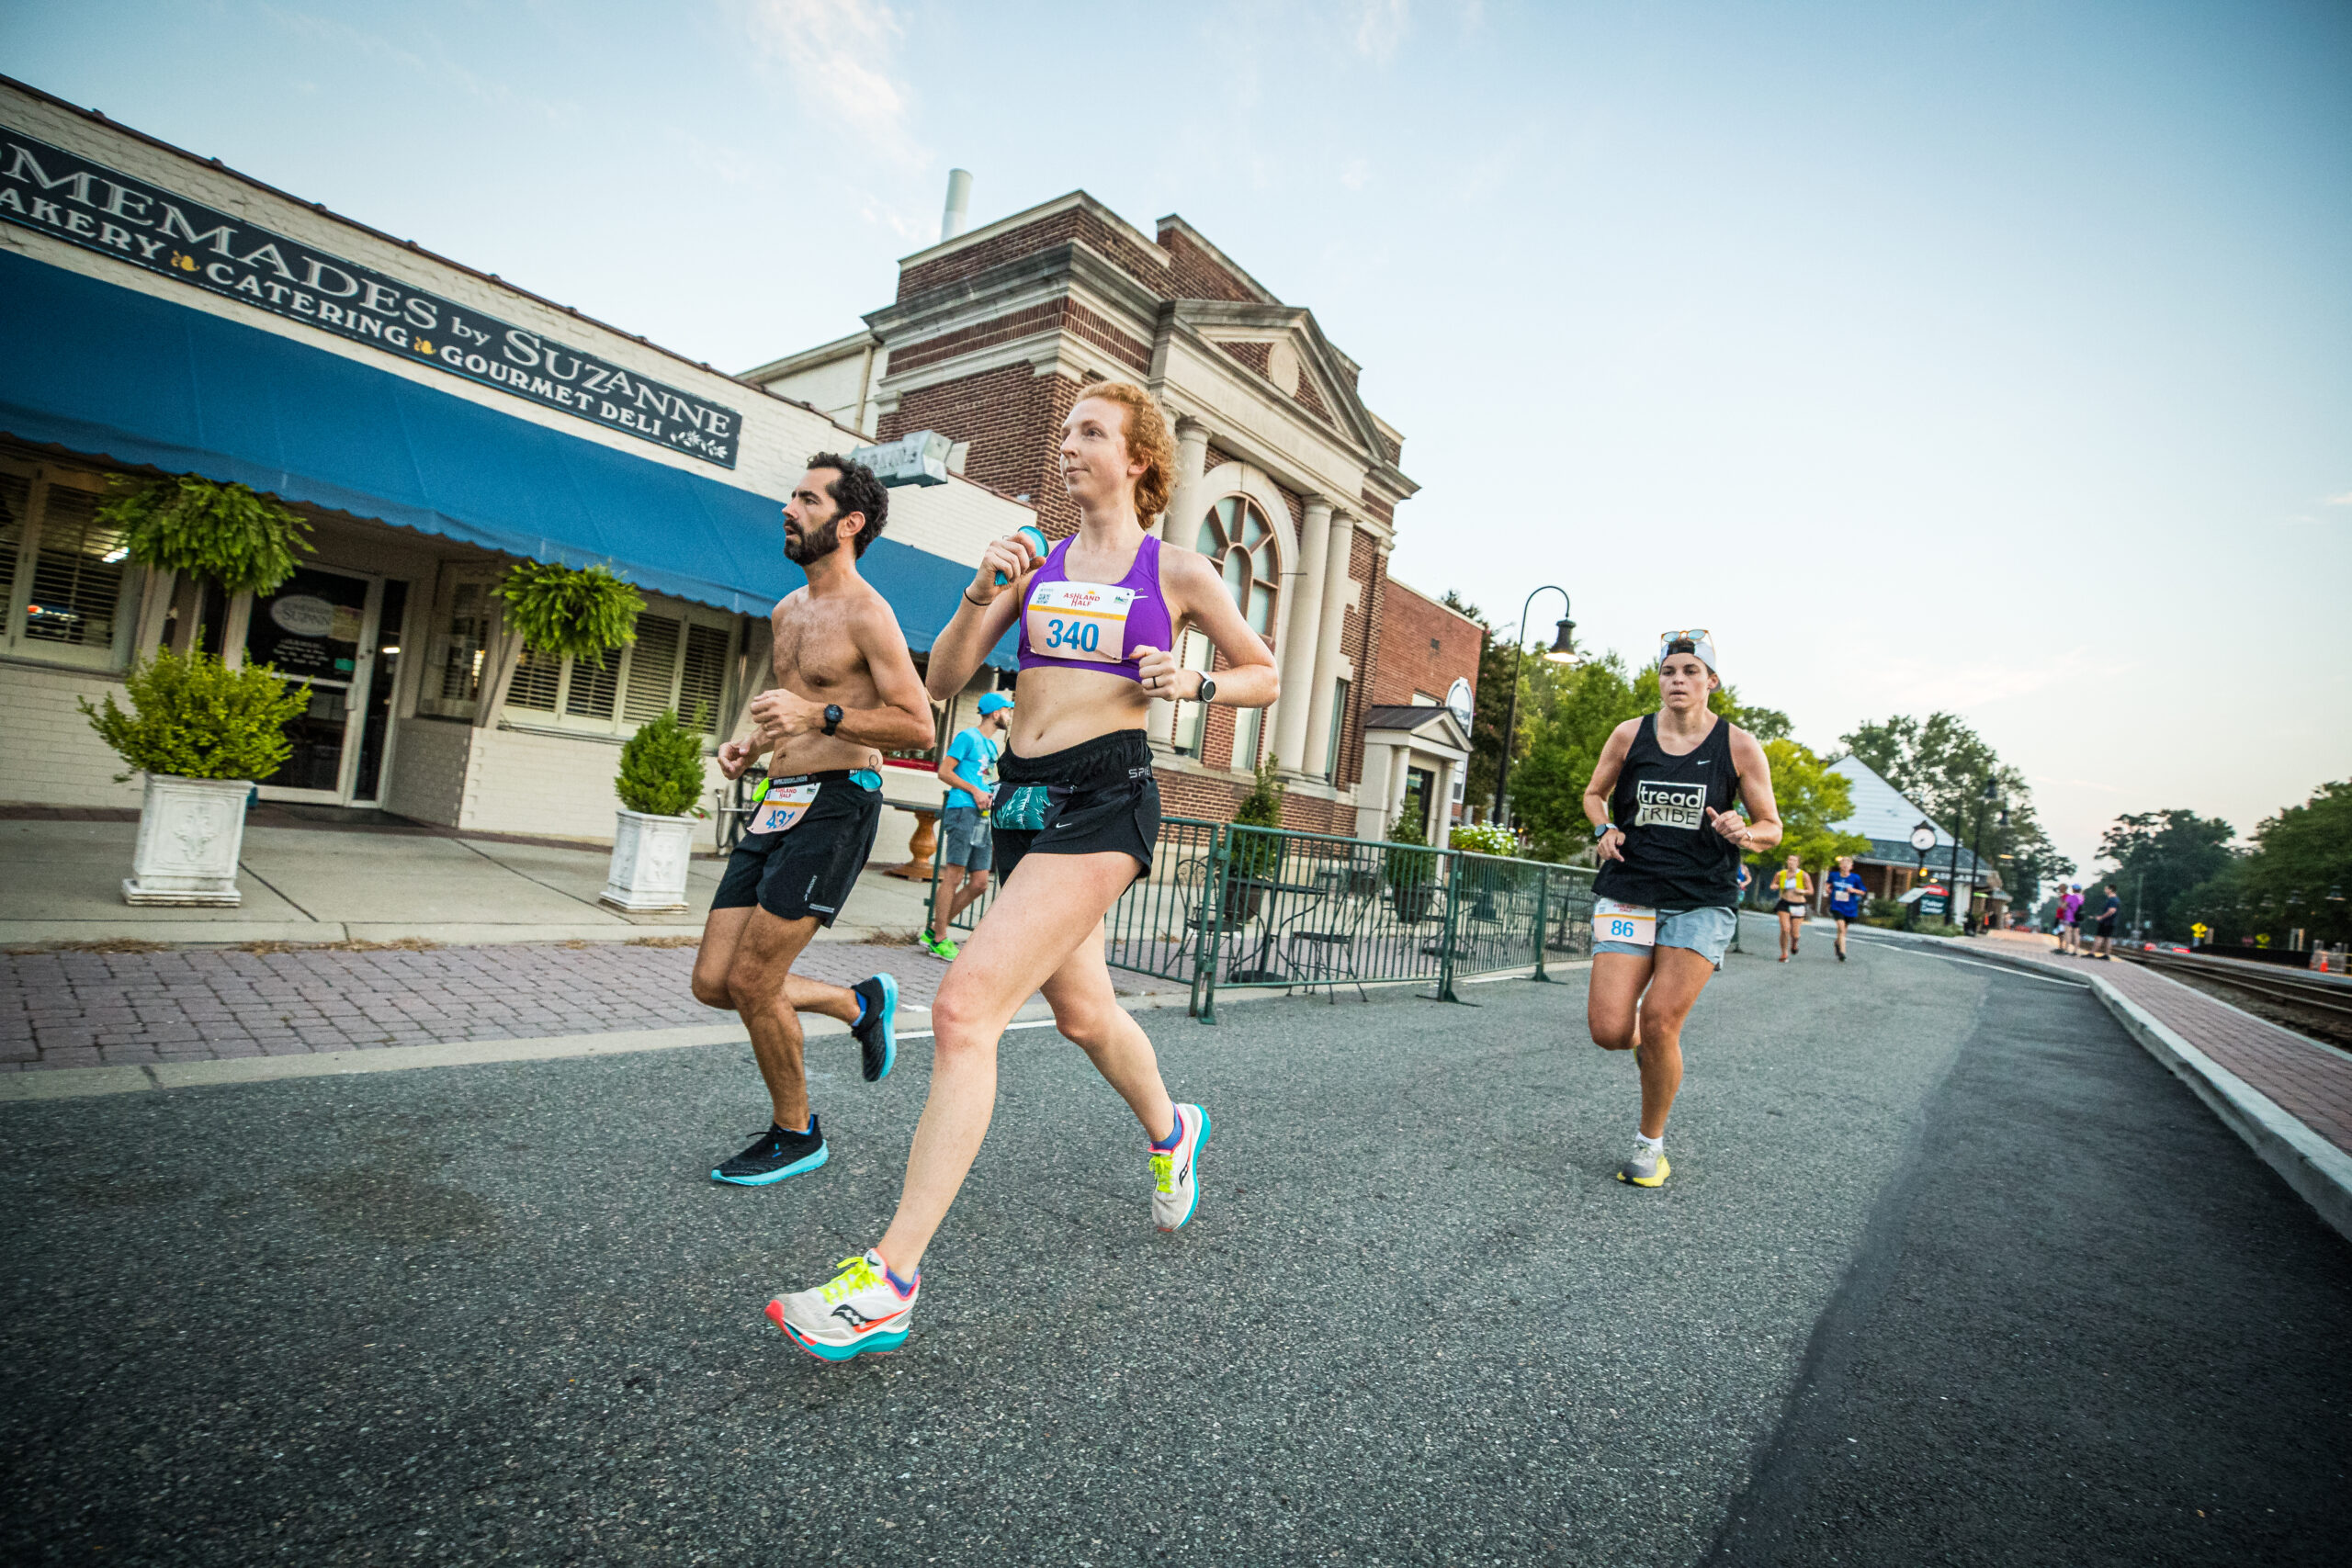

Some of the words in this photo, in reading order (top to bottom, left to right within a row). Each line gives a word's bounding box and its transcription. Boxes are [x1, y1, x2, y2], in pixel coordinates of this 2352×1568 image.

[0, 142, 437, 330] MEMADES
[451, 316, 492, 346] by
[503, 329, 730, 438] SUZANNE
[206, 262, 409, 348] CATERING
[440, 345, 594, 411] GOURMET
[600, 400, 662, 437] DELI
[1063, 592, 1100, 602] ASHLAND
[1071, 597, 1091, 606] HALF
[1046, 618, 1100, 653] 340
[1640, 785, 1702, 808] tread
[765, 809, 796, 829] 431
[1642, 807, 1699, 825] TRIBE
[1611, 919, 1634, 938] 86
